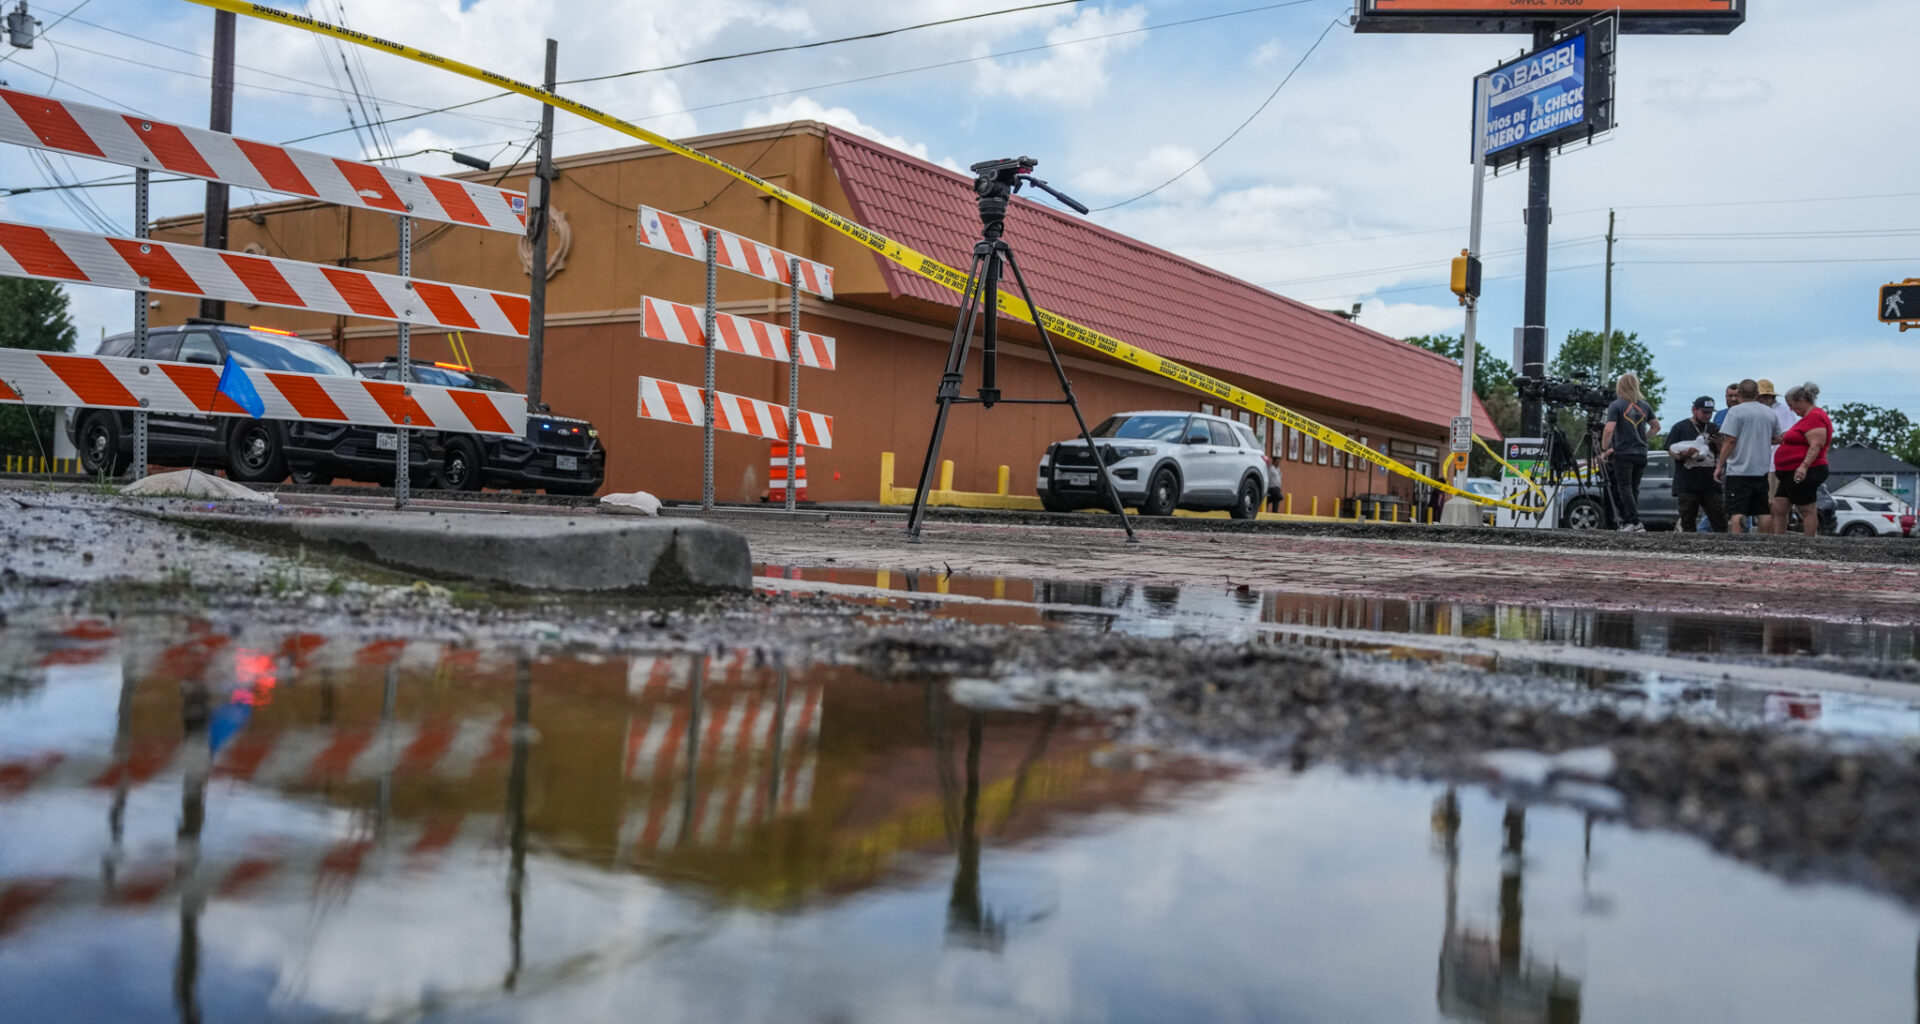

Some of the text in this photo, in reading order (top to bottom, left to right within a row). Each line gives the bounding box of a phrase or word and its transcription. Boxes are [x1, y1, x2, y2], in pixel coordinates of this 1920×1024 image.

[252, 4, 404, 51] CRIME SCENE DO NOT CROSS
[1514, 43, 1575, 86] BARRI
[1545, 87, 1584, 113] CHECK
[1487, 109, 1527, 133] VÍOS DE
[1529, 103, 1583, 134] CASHING
[1484, 124, 1525, 151] INERO
[811, 206, 829, 220] CROSS
[830, 218, 841, 227] NOT
[842, 224, 850, 232] DO
[851, 229, 868, 242] SCENE
[868, 238, 885, 251] CRIME
[919, 265, 934, 276] CROSS
[922, 259, 939, 271] CRUZAR
[934, 272, 944, 281] NOT
[945, 270, 960, 280] CRIMEN
[951, 280, 964, 290] SCENE
[1036, 311, 1056, 323] CRUZA
[1053, 324, 1065, 333] NOT
[1066, 323, 1087, 335] CRIMEN
[1067, 330, 1076, 338] DO
[1078, 334, 1096, 346] SCENE
[1098, 335, 1118, 347] ESCENA
[1098, 342, 1116, 353] CRIME
[1159, 367, 1176, 376] CROSS
[1178, 373, 1188, 381] NOT
[1198, 381, 1213, 391] SCENE
[1215, 388, 1230, 397] CRIME
